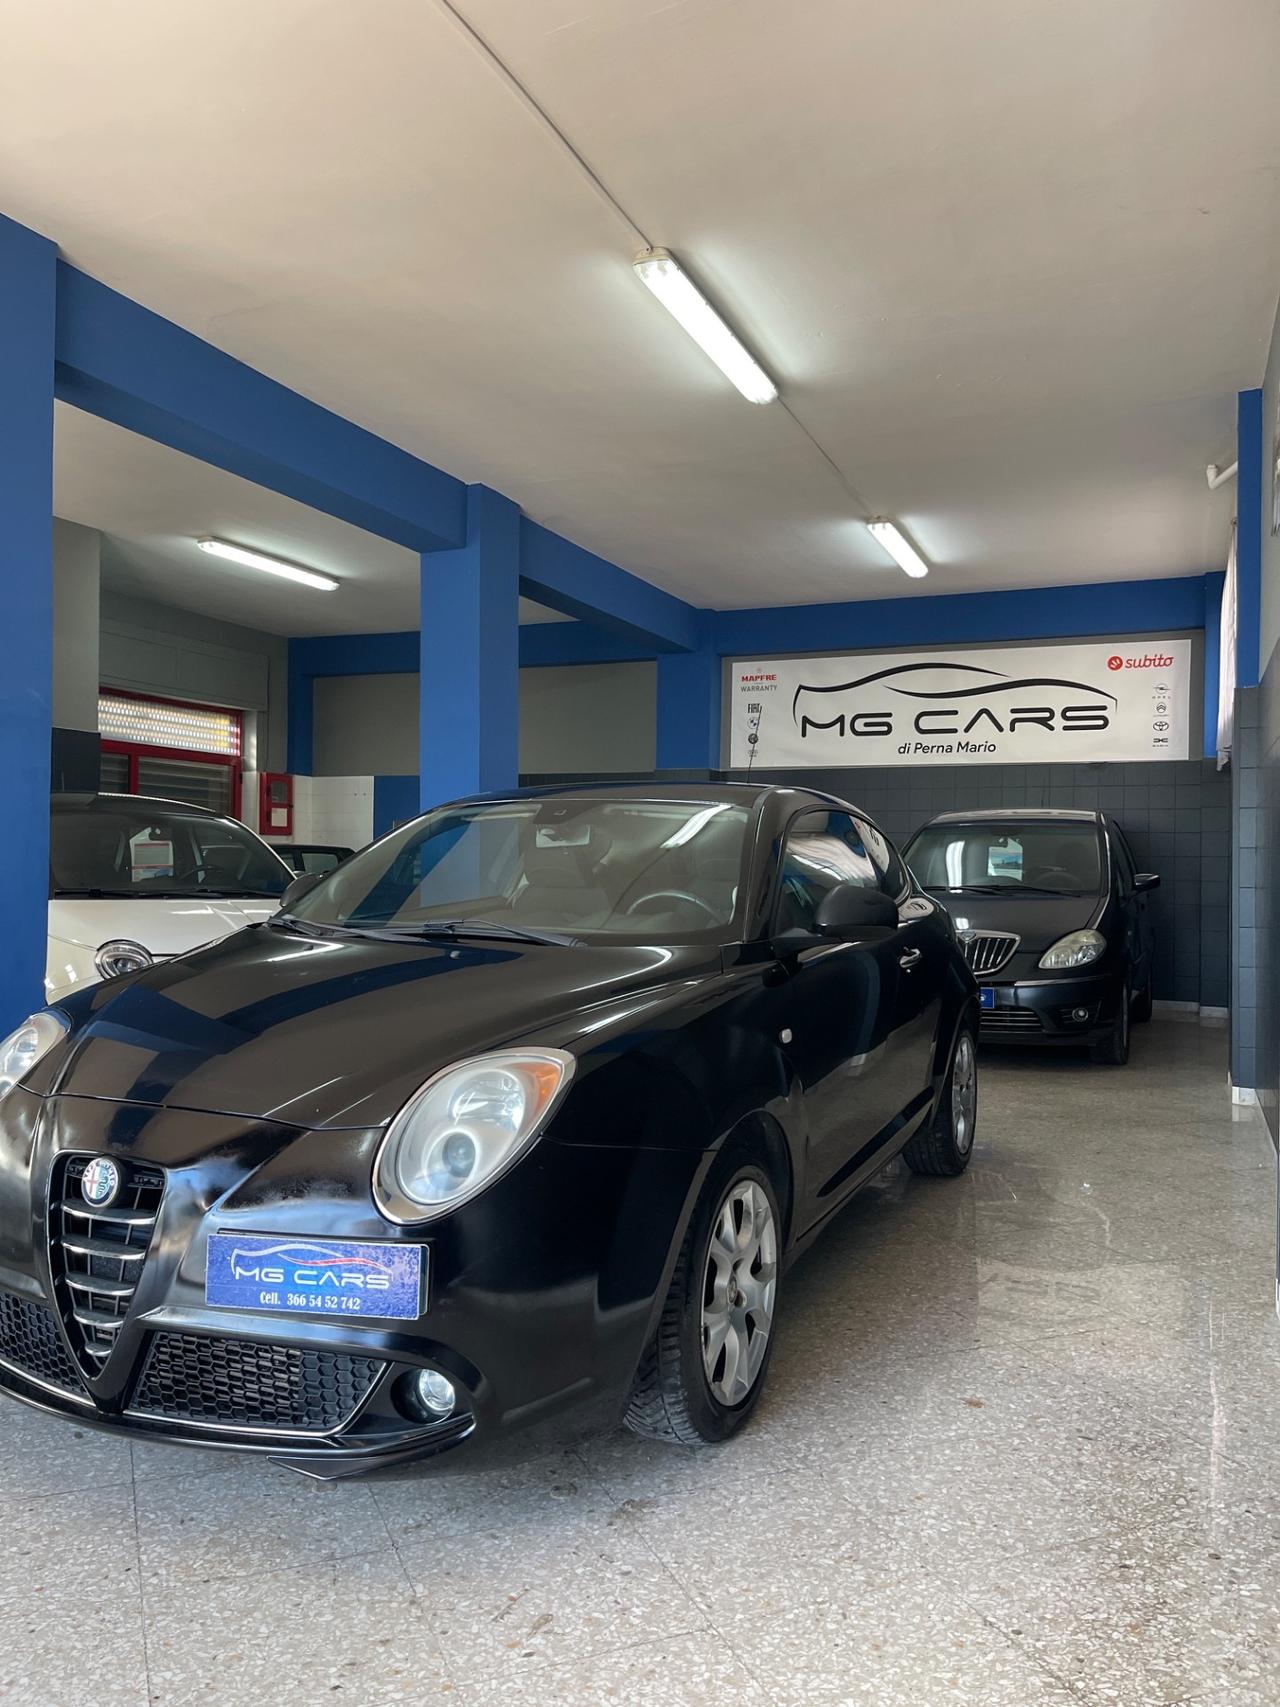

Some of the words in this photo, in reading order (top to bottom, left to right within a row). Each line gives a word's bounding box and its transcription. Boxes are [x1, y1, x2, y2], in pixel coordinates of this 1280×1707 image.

[1124, 654, 1174, 669] subito
[741, 674, 777, 683] MAPFRE
[740, 684, 777, 693] WARRANTY
[801, 712, 893, 738] MG
[914, 705, 1109, 735] CARS
[898, 742, 911, 755] di
[913, 742, 953, 755] Perna
[957, 740, 997, 754] Mario
[235, 1266, 284, 1283] MG
[294, 1270, 390, 1290] CARS
[260, 1291, 281, 1305] Cell.
[287, 1294, 306, 1307] 366
[309, 1295, 322, 1308] 54
[324, 1295, 338, 1309] 52
[341, 1297, 361, 1311] 742
